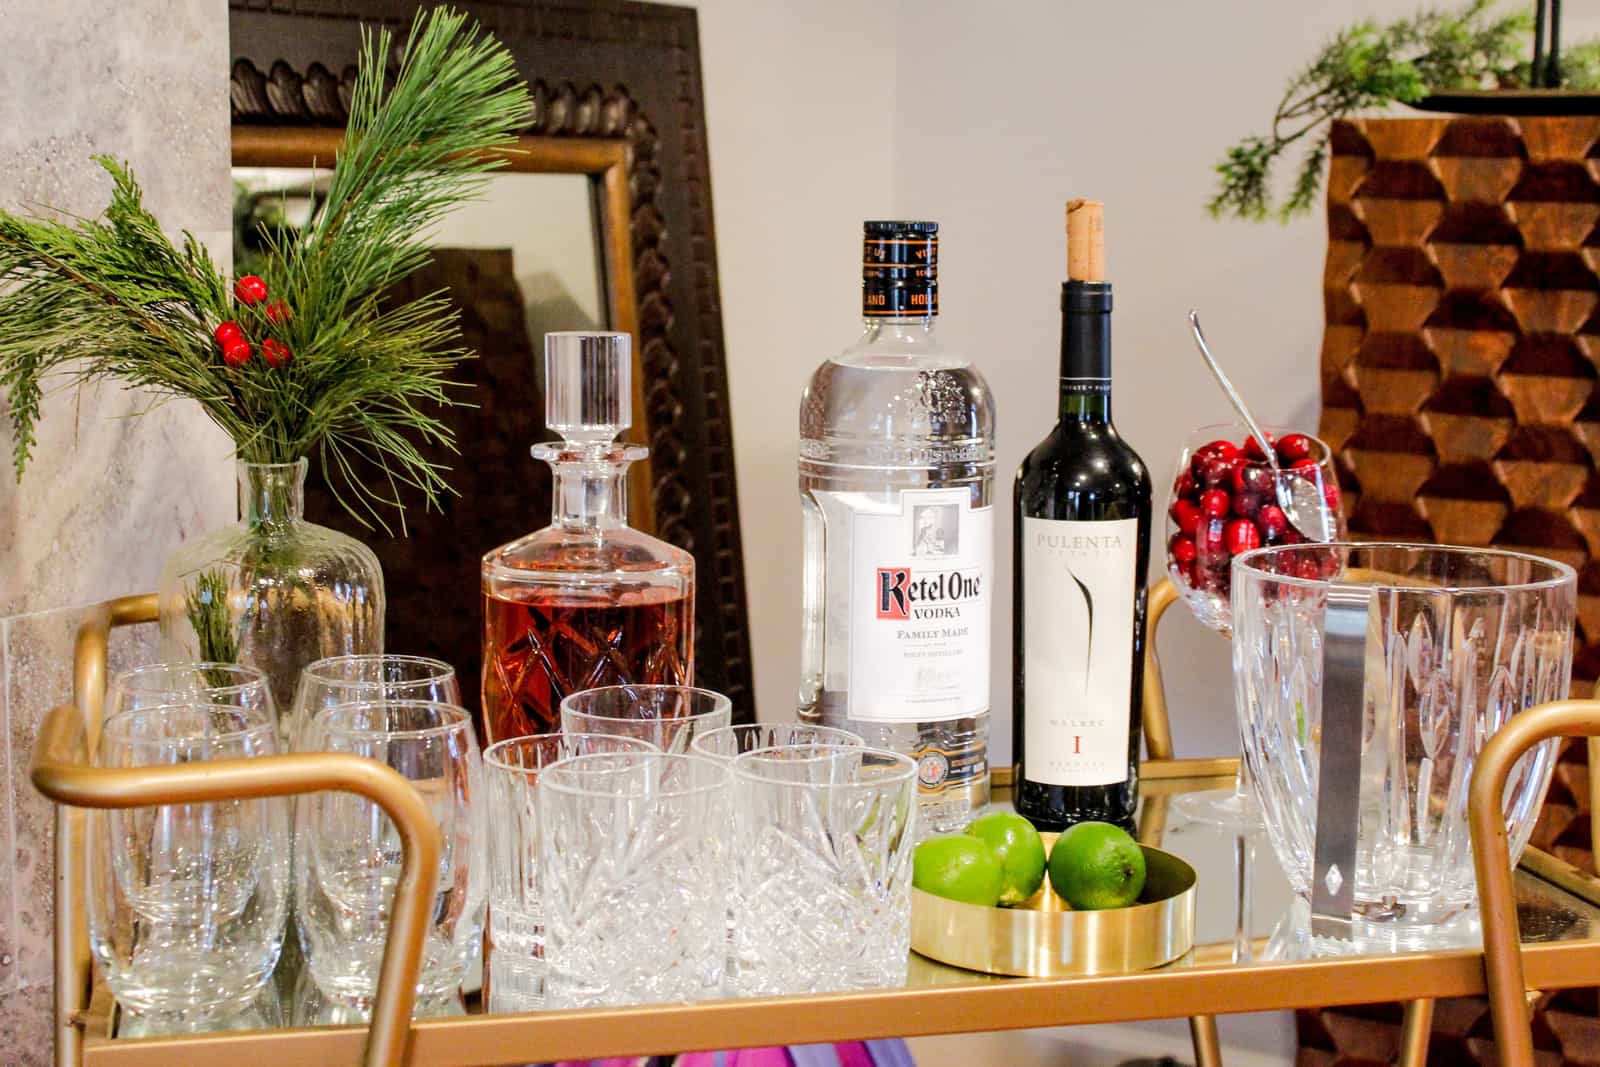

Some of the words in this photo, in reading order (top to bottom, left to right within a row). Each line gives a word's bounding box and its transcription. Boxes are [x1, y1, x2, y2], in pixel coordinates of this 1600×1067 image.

[1037, 533, 1122, 549] PULENTA
[880, 571, 945, 616] Ketel
[948, 571, 981, 601] One
[914, 606, 961, 620] VODKA
[897, 629, 941, 641] FAMILY
